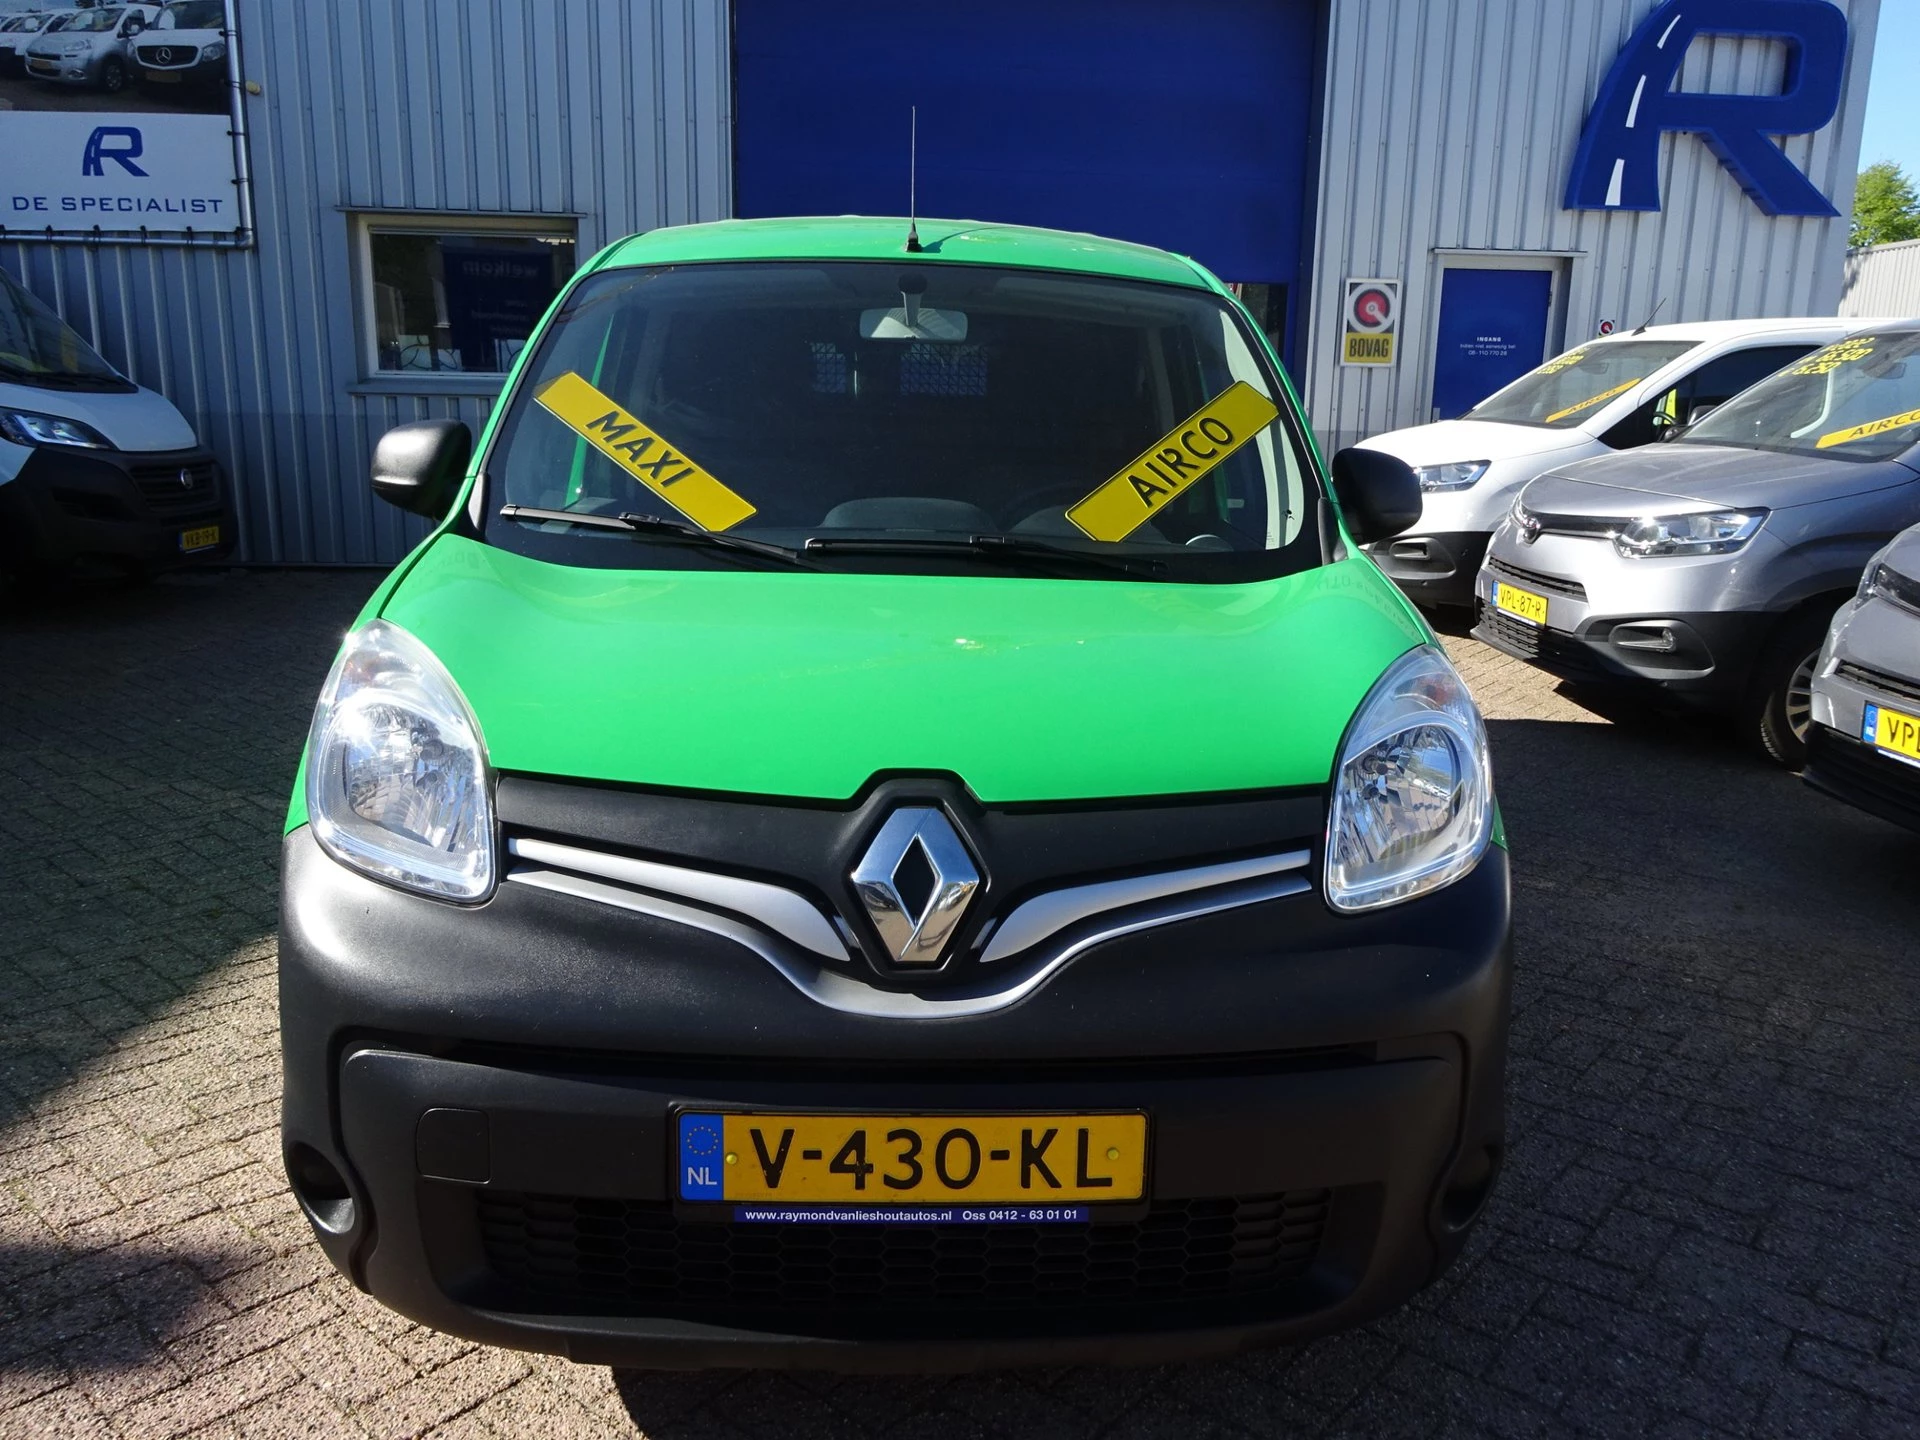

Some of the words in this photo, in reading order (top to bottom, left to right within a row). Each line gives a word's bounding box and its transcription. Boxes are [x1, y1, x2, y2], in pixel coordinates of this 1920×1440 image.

[12, 197, 49, 211] DE
[61, 197, 223, 213] SPECIALIST
[1349, 338, 1389, 357] BOVAG
[586, 410, 695, 488] MAXI
[1126, 417, 1234, 508] AIRCO
[749, 1127, 1113, 1190] V-430-KL
[687, 1167, 717, 1185] NL
[745, 1210, 952, 1222] www.raymondvanlieshoutautos.nl
[962, 1210, 986, 1221] Oss
[988, 1210, 1018, 1220] 0412
[1029, 1209, 1044, 1220] 63
[1046, 1209, 1061, 1220] 01
[1063, 1209, 1078, 1220] 01
